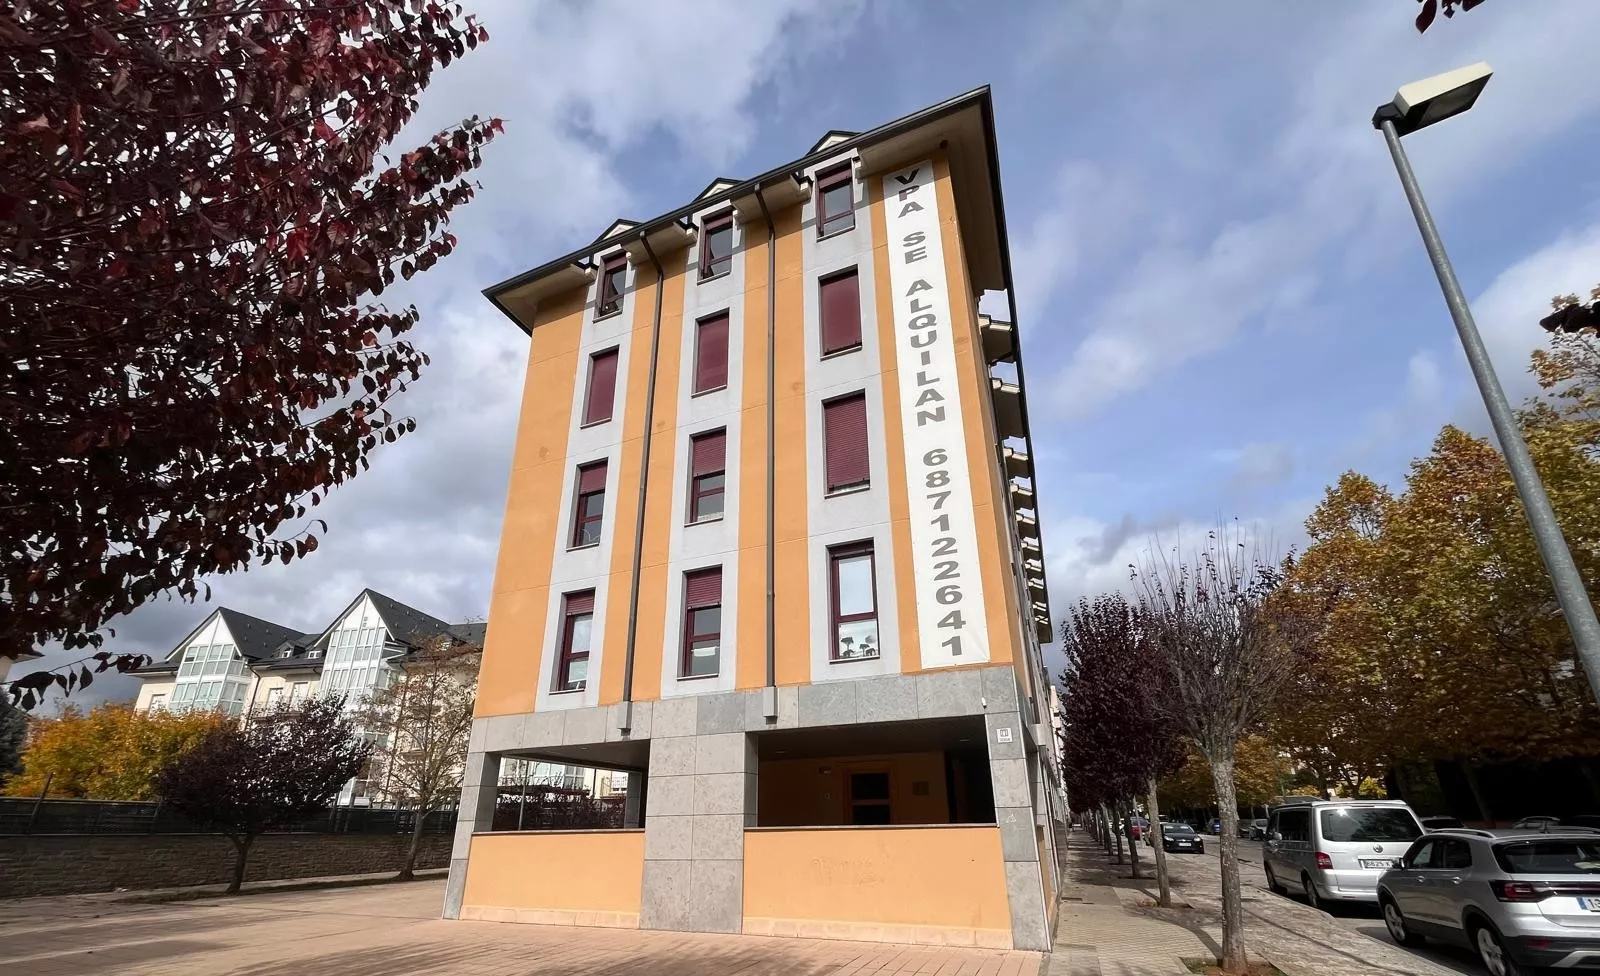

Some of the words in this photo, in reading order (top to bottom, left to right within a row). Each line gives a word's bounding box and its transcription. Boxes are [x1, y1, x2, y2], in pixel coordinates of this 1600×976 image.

[894, 167, 925, 218] VPA
[902, 231, 928, 265] SE
[905, 278, 946, 427] ALQUILAN
[922, 448, 967, 656] 687122641
